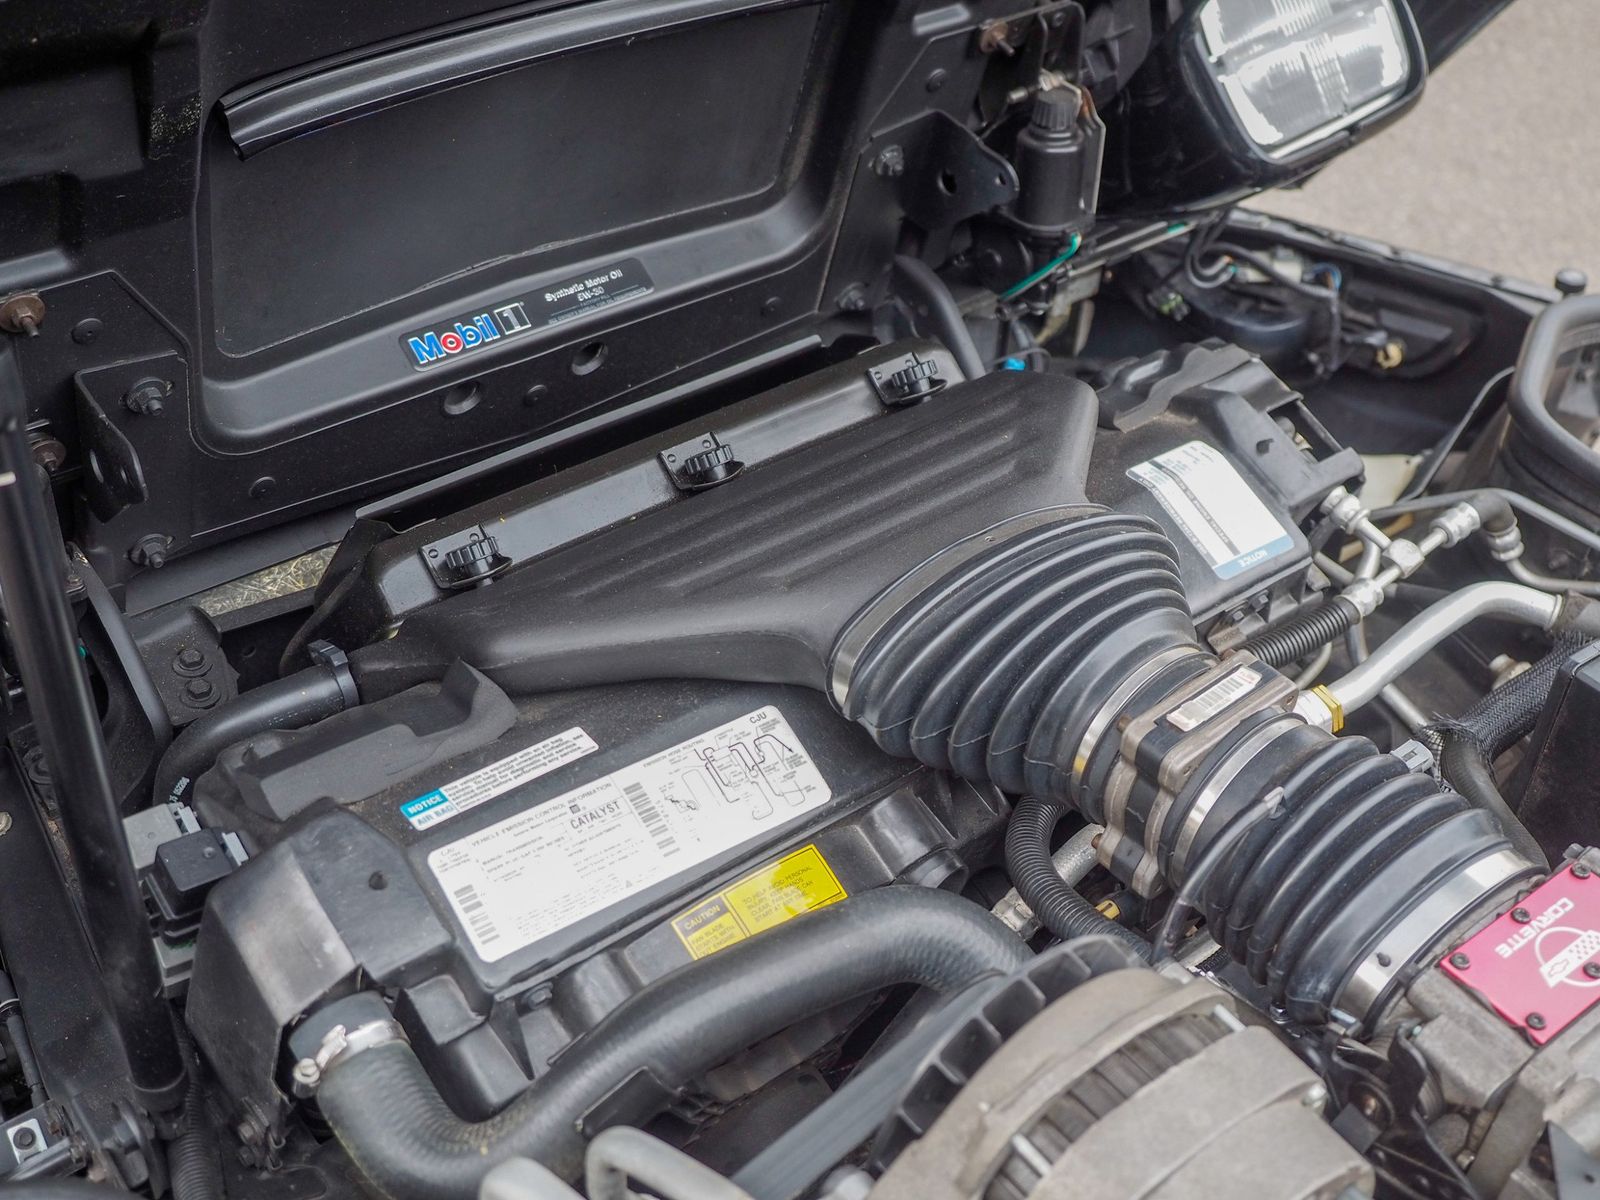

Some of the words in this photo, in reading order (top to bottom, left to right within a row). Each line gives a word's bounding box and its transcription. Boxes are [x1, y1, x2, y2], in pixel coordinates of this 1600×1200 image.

[545, 283, 585, 302] Synthetic
[584, 275, 610, 290] Motor
[609, 269, 623, 281] Oil
[577, 286, 605, 301] 5W-30
[408, 313, 501, 364] Mobil
[1239, 549, 1268, 568] NOTICE
[749, 712, 767, 724] CJU
[406, 793, 444, 815] NOTICE
[414, 813, 433, 825] AIR
[432, 803, 454, 817] BAG
[570, 801, 622, 829] CATALYST
[684, 905, 721, 930] CAUTION
[1494, 897, 1575, 959] CORVETTE
